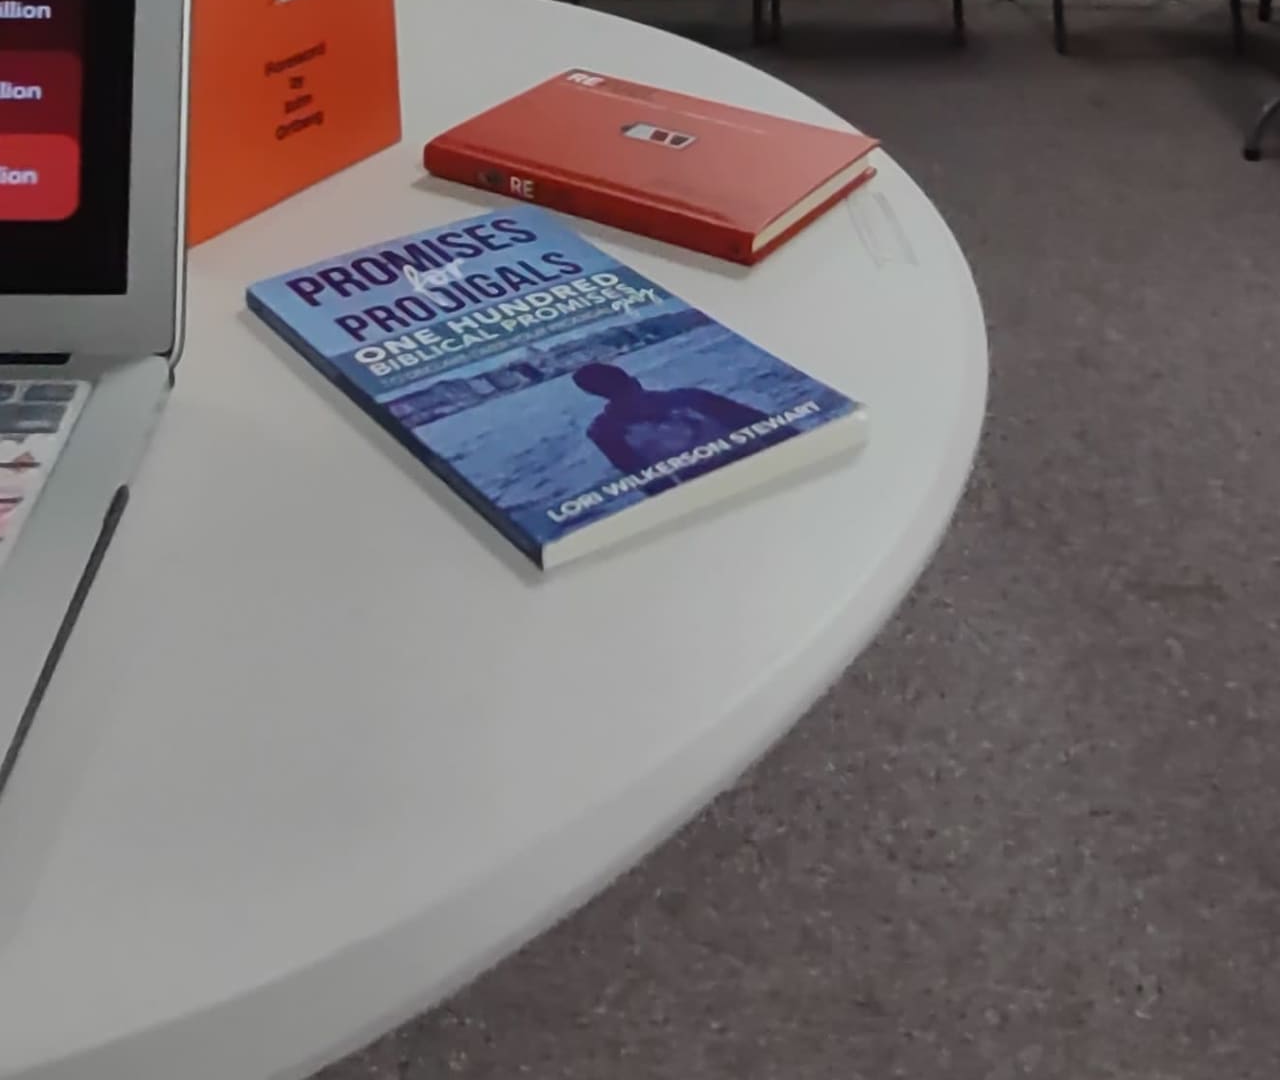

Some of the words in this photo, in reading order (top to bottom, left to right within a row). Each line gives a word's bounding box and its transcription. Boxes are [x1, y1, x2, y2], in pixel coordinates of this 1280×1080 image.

[285, 218, 538, 308] PROMISES
[334, 251, 584, 342] PRODIGALS
[354, 328, 443, 365] ONE
[447, 272, 620, 335] HUNDRED
[368, 329, 500, 377] BIBLICAL
[500, 283, 638, 332] PROMISES
[546, 490, 602, 523] LORI
[601, 438, 730, 497] WILKERSON
[728, 400, 821, 445] STEWART
